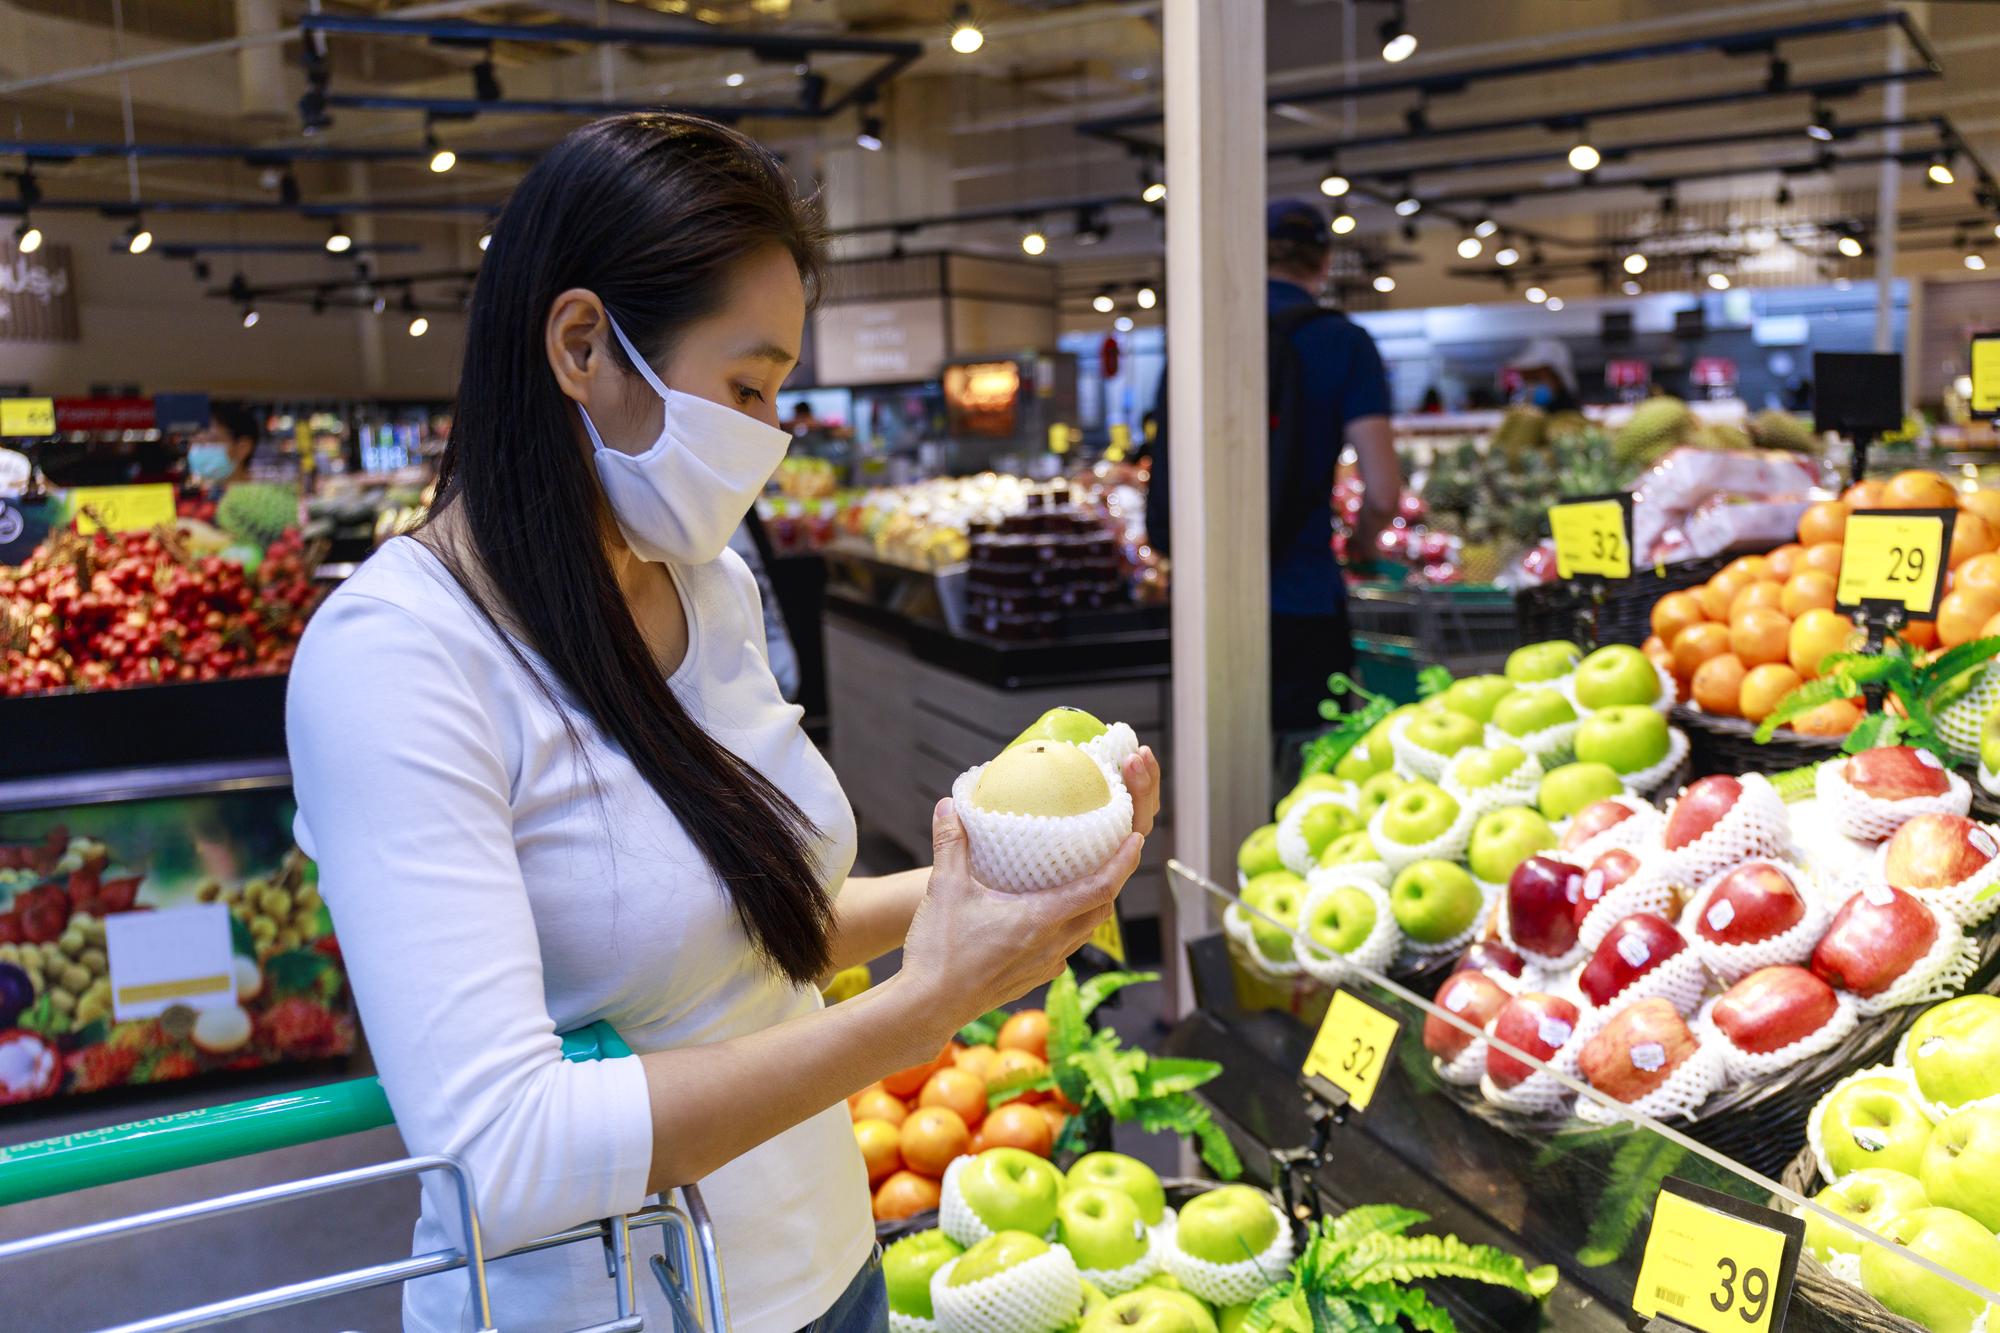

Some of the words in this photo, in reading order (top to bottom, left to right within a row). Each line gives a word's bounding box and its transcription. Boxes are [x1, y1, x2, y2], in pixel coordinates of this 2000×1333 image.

[1592, 529, 1621, 562] 32
[1886, 547, 1925, 582] 29
[1343, 1037, 1376, 1081] 32
[1710, 1257, 1769, 1324] 39
